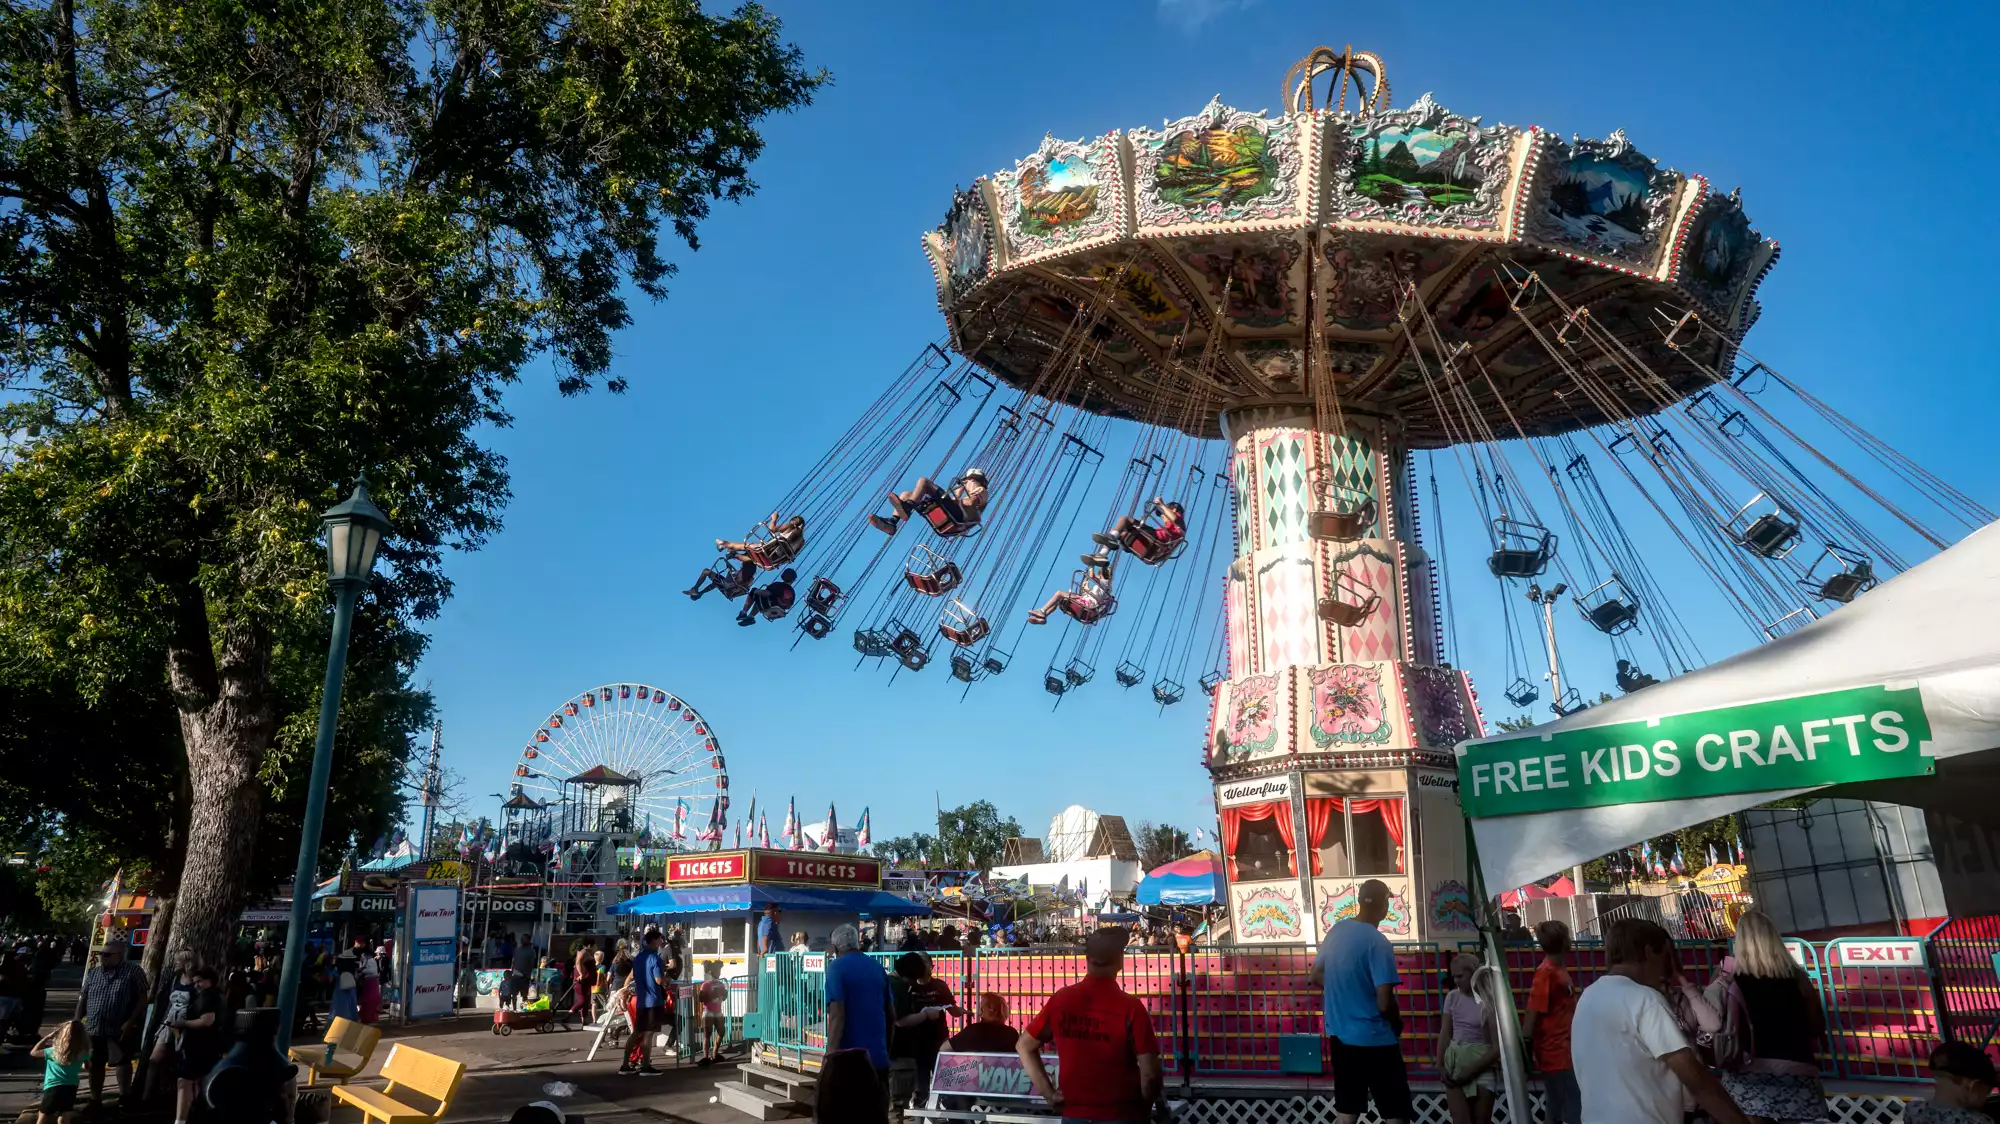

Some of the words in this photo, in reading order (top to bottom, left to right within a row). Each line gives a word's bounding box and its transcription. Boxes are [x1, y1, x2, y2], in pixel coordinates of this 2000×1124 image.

[1472, 753, 1570, 798] FREE
[1581, 739, 1682, 785] KIDS
[1695, 710, 1910, 772] CRAFTS
[1223, 781, 1289, 800] Wellenflug
[679, 860, 732, 876] TICKETS
[788, 861, 856, 879] TICKETS
[360, 898, 397, 910] CHIL
[492, 900, 536, 912] DOGS
[1846, 946, 1914, 961] EXIT
[805, 958, 823, 968] EXIT
[978, 1063, 1031, 1094] WAVE
